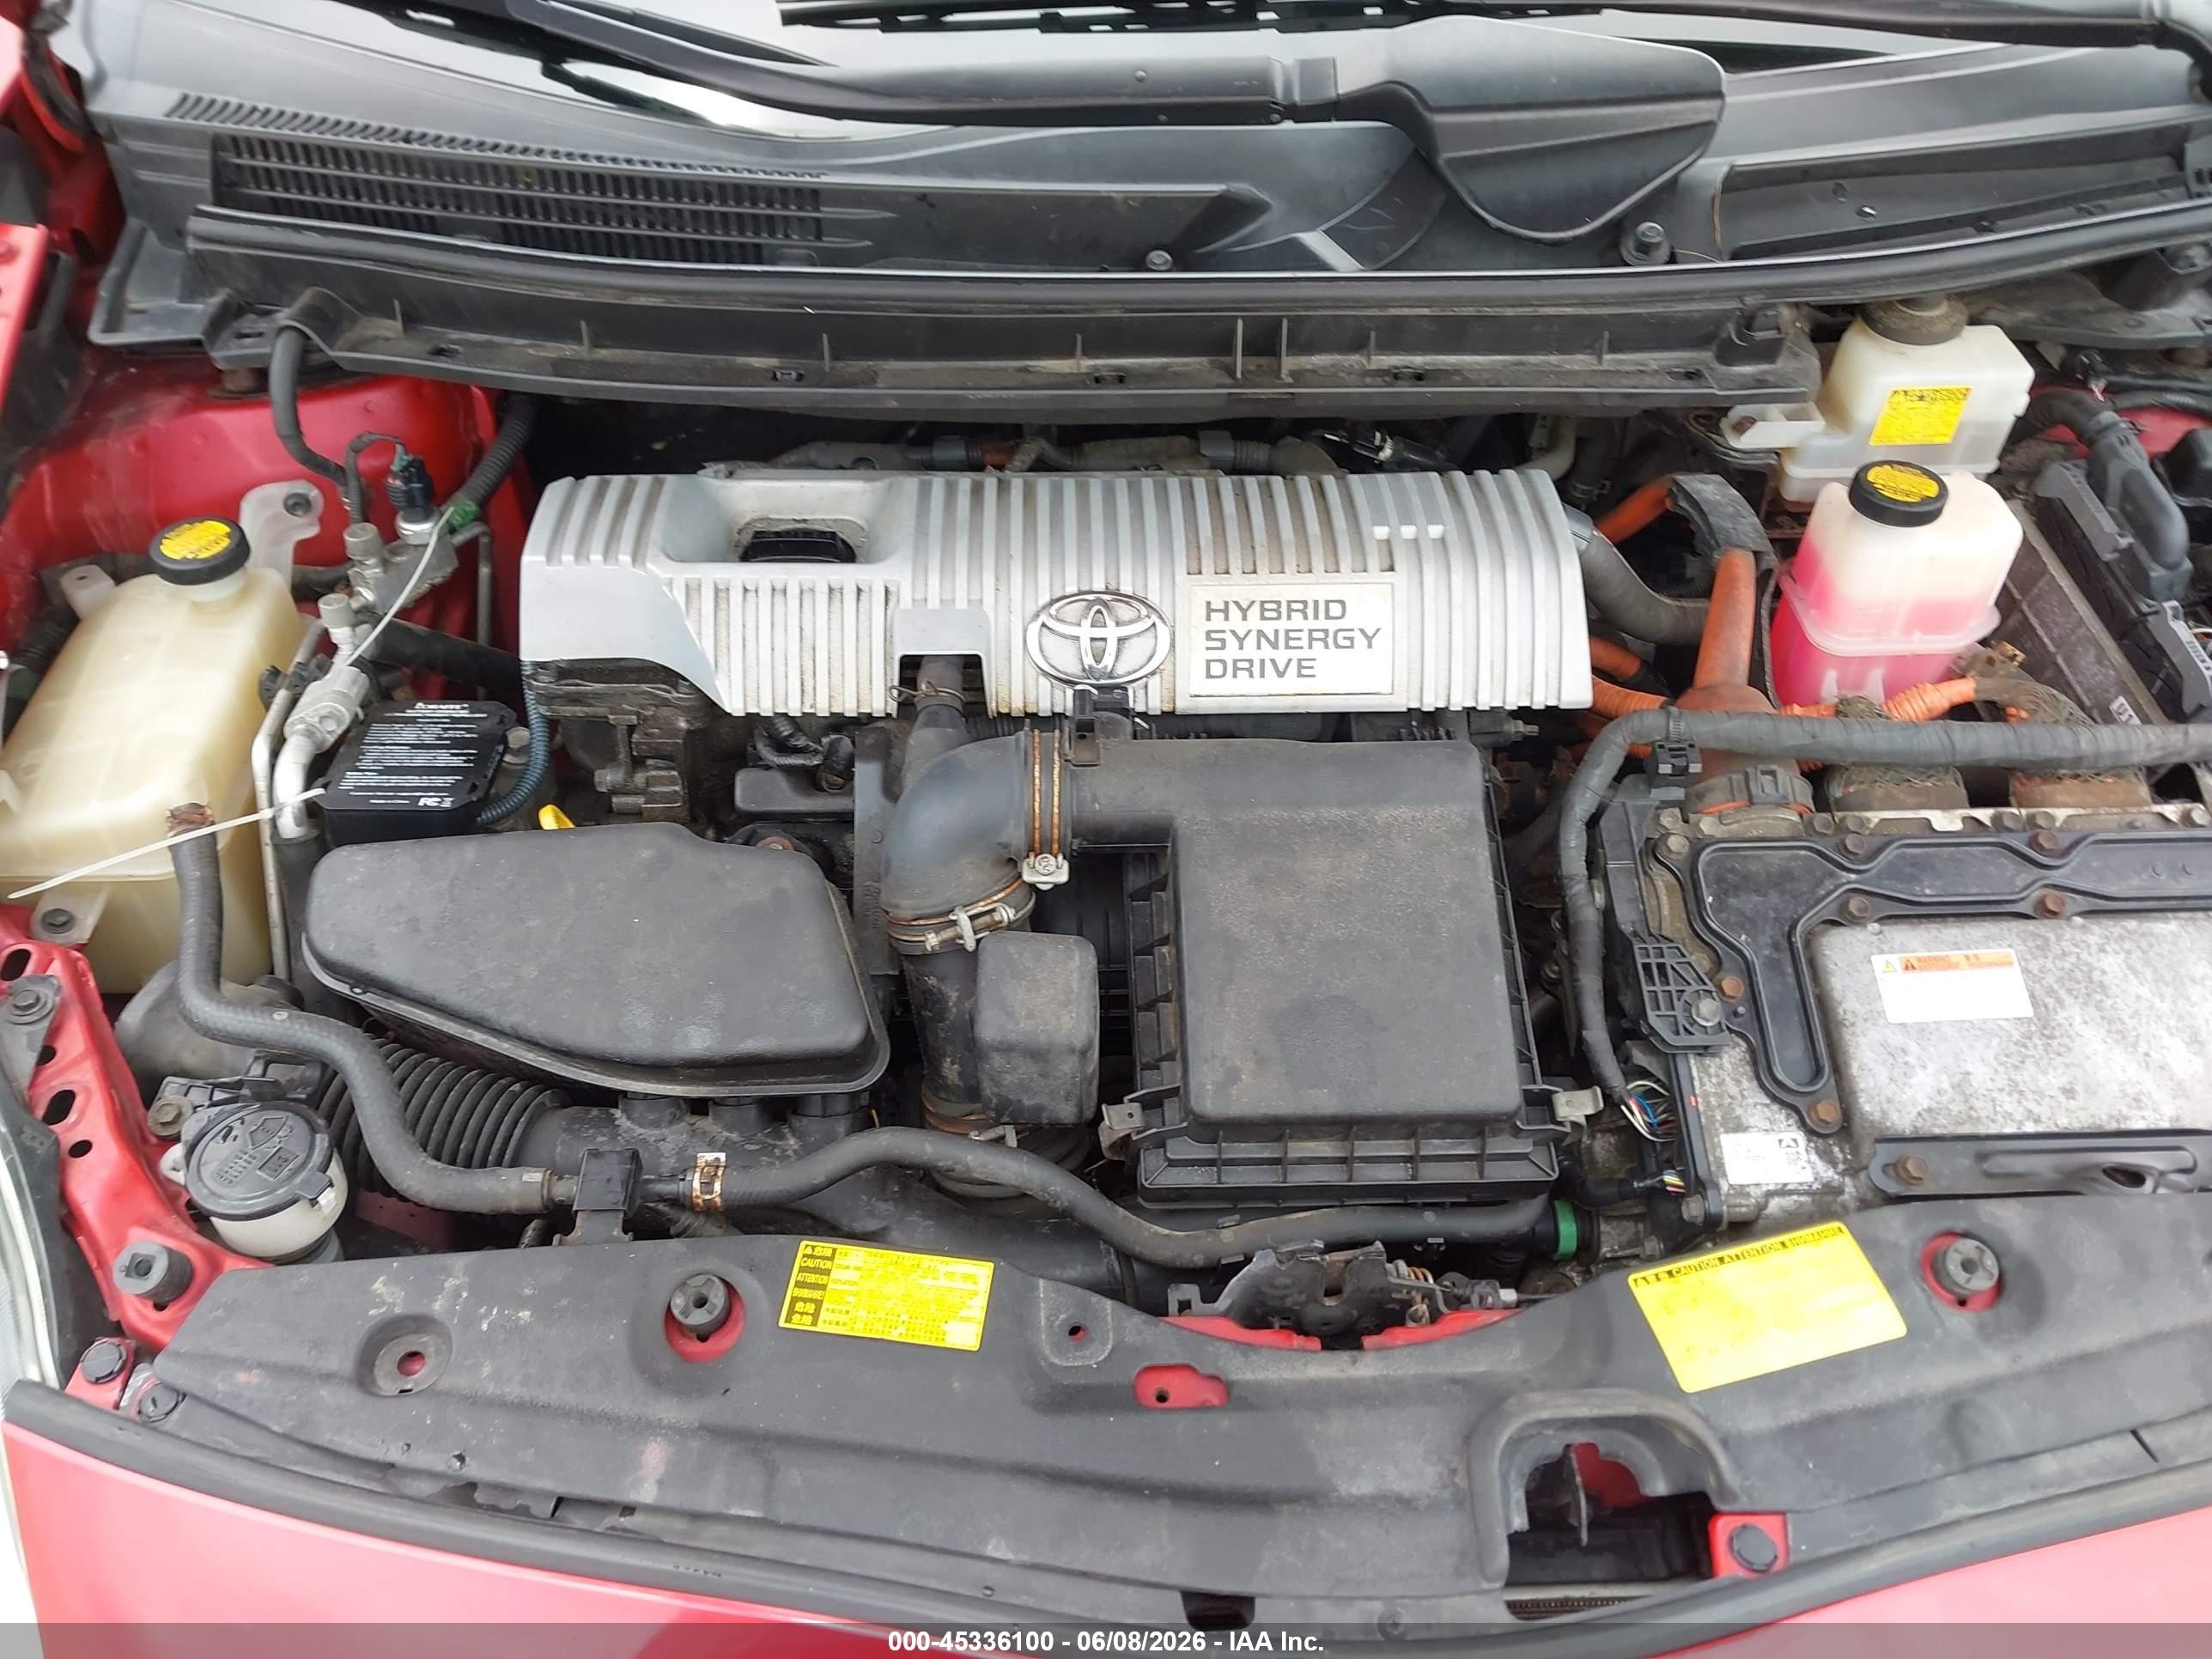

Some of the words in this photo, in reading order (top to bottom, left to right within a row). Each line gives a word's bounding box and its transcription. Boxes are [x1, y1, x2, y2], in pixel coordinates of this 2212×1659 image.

[1206, 599, 1346, 621] HYBRID
[1206, 629, 1382, 650] SYNERGY
[1206, 658, 1316, 679] DRIVE
[801, 1258, 833, 1269] CAUTION
[1672, 1257, 1720, 1277] CAUTION
[1723, 1241, 1783, 1264] ATTENTION
